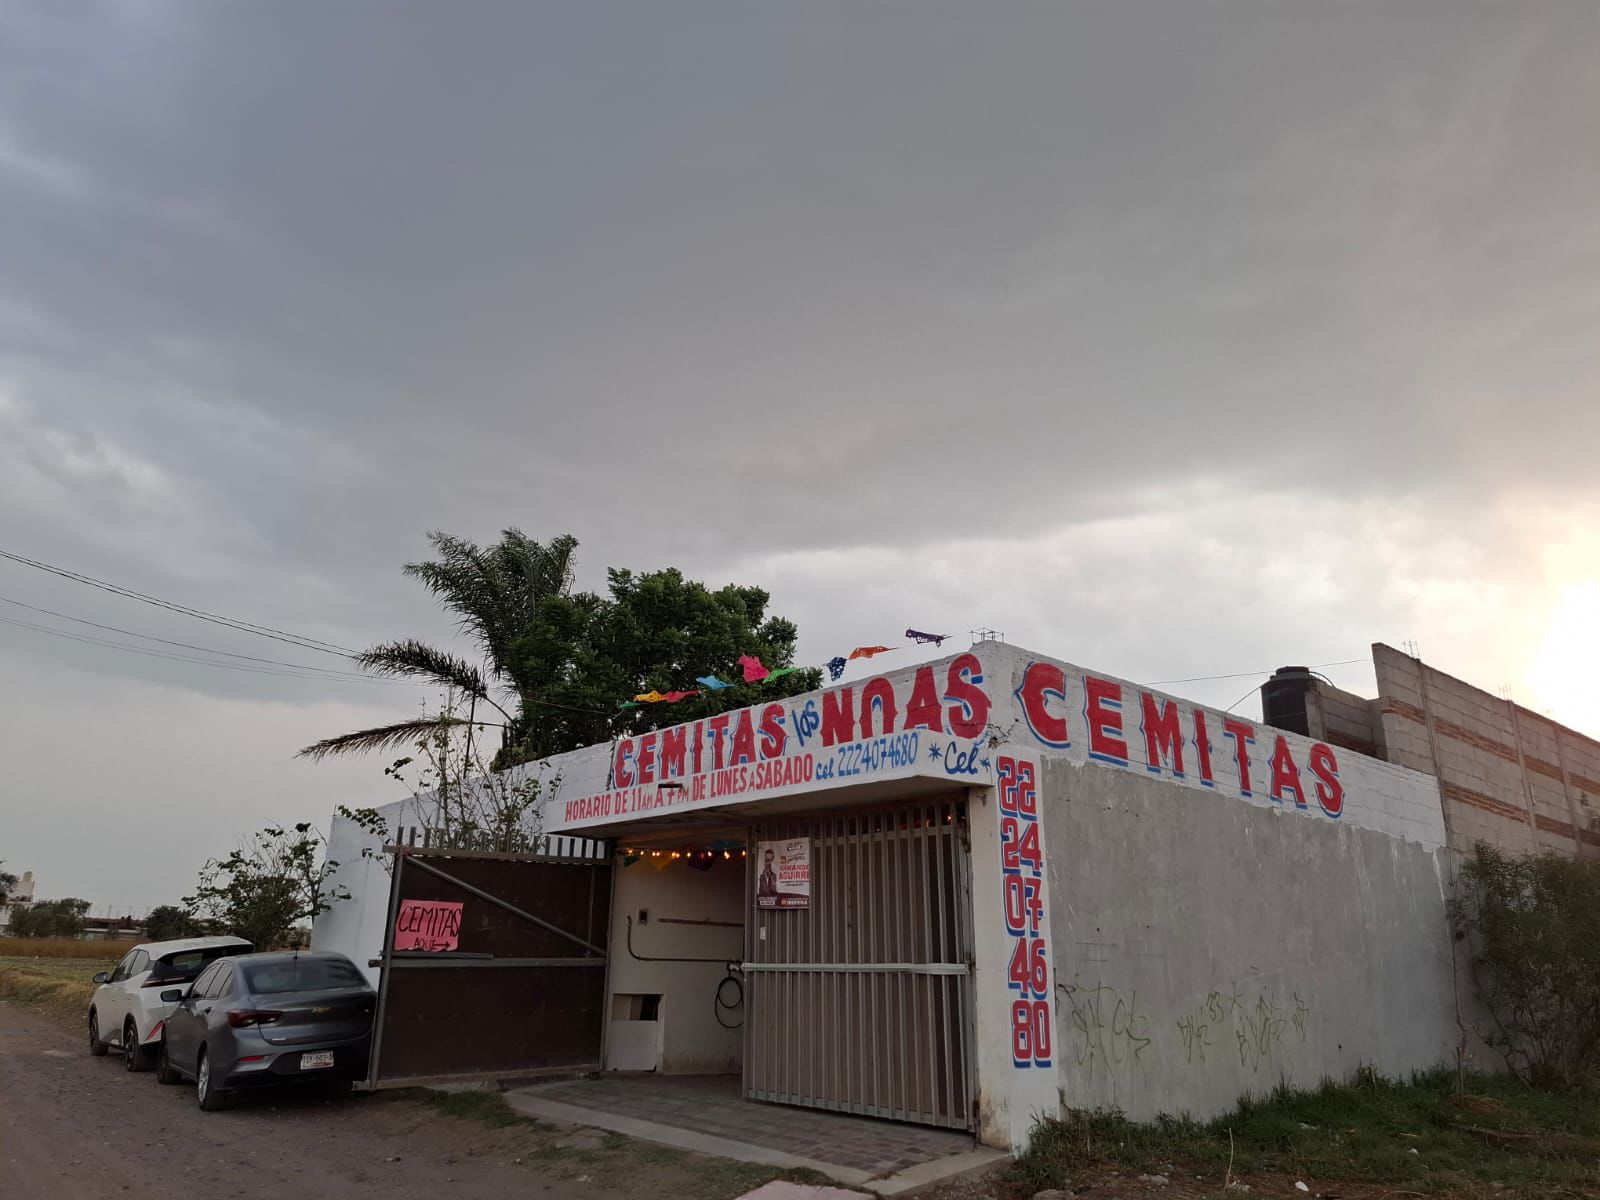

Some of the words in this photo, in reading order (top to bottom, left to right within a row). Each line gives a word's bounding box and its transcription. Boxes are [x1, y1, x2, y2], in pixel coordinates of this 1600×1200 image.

[565, 791, 610, 823] HORARIO
[614, 791, 628, 815] DE
[692, 772, 707, 801] DE
[710, 765, 747, 798] LUNES
[756, 753, 813, 790] SABADO
[838, 732, 918, 776] 2224074680
[613, 703, 789, 789] CEMITAS
[1015, 661, 1345, 818] CEMITAS
[398, 905, 461, 938] CEMITAS
